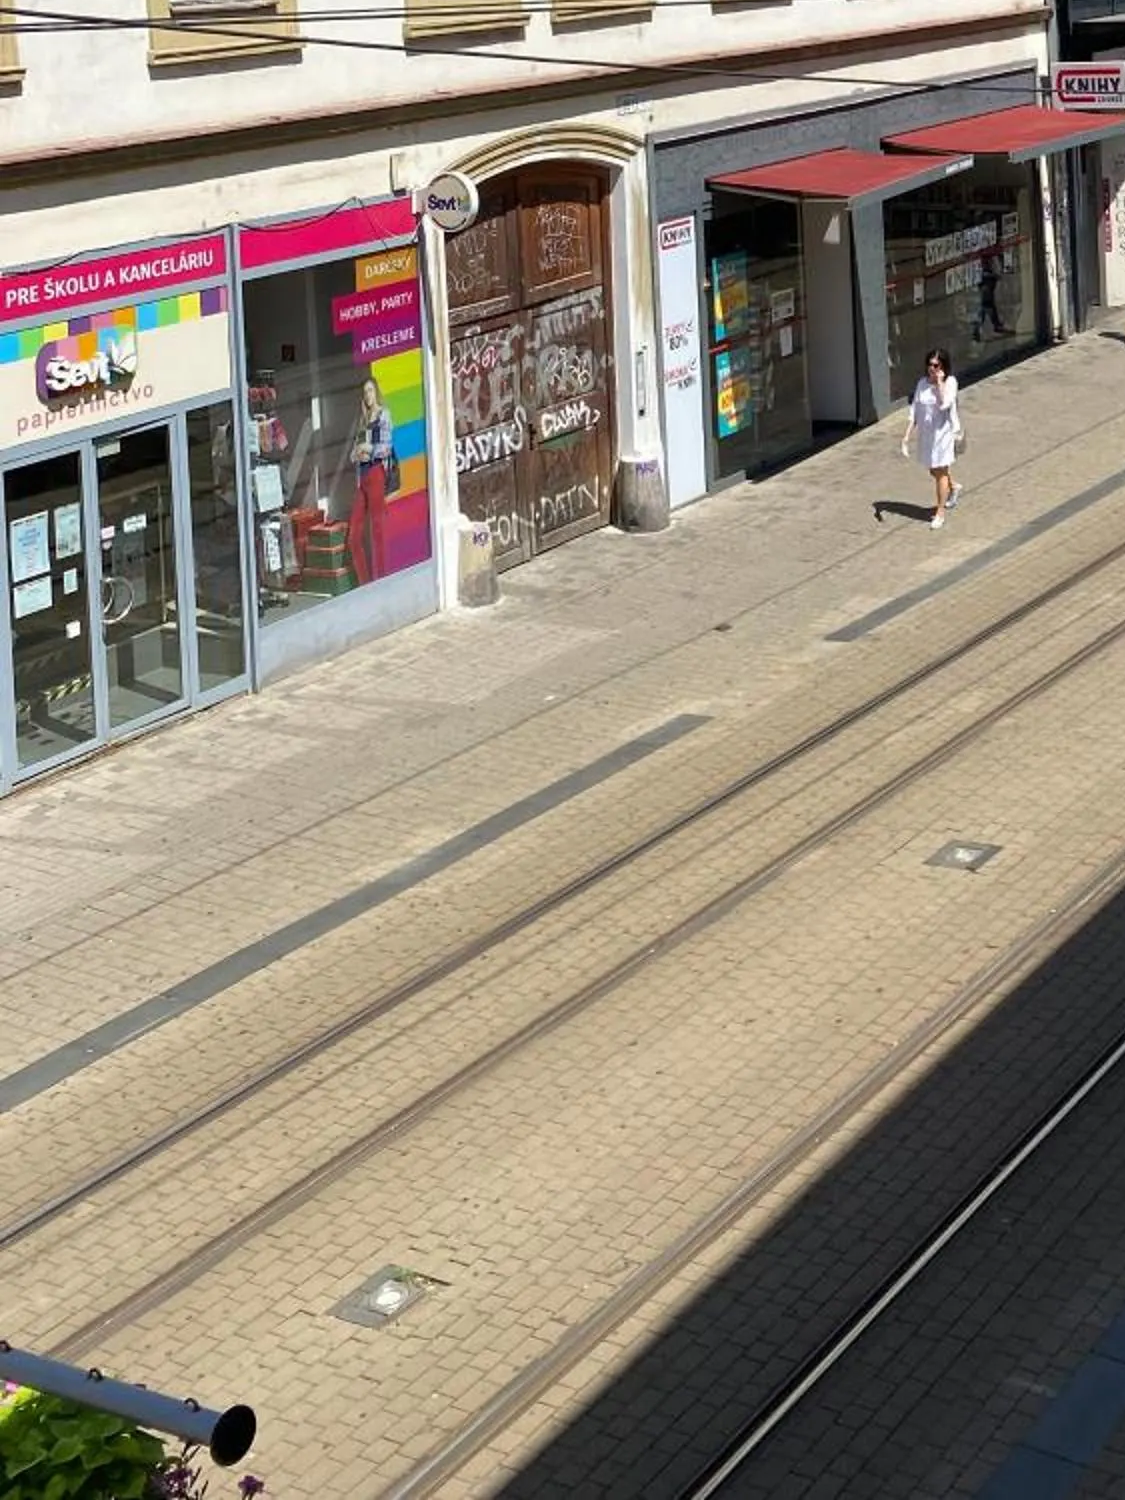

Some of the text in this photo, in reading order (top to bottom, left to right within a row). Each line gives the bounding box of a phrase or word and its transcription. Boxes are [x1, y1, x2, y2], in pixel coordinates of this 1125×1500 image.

[1064, 77, 1121, 94] KNIHY
[6, 249, 214, 309] PRE ŠKOLU A KANCELÁRIU
[381, 291, 414, 311] PARTY
[17, 384, 154, 436] papiernictvo
